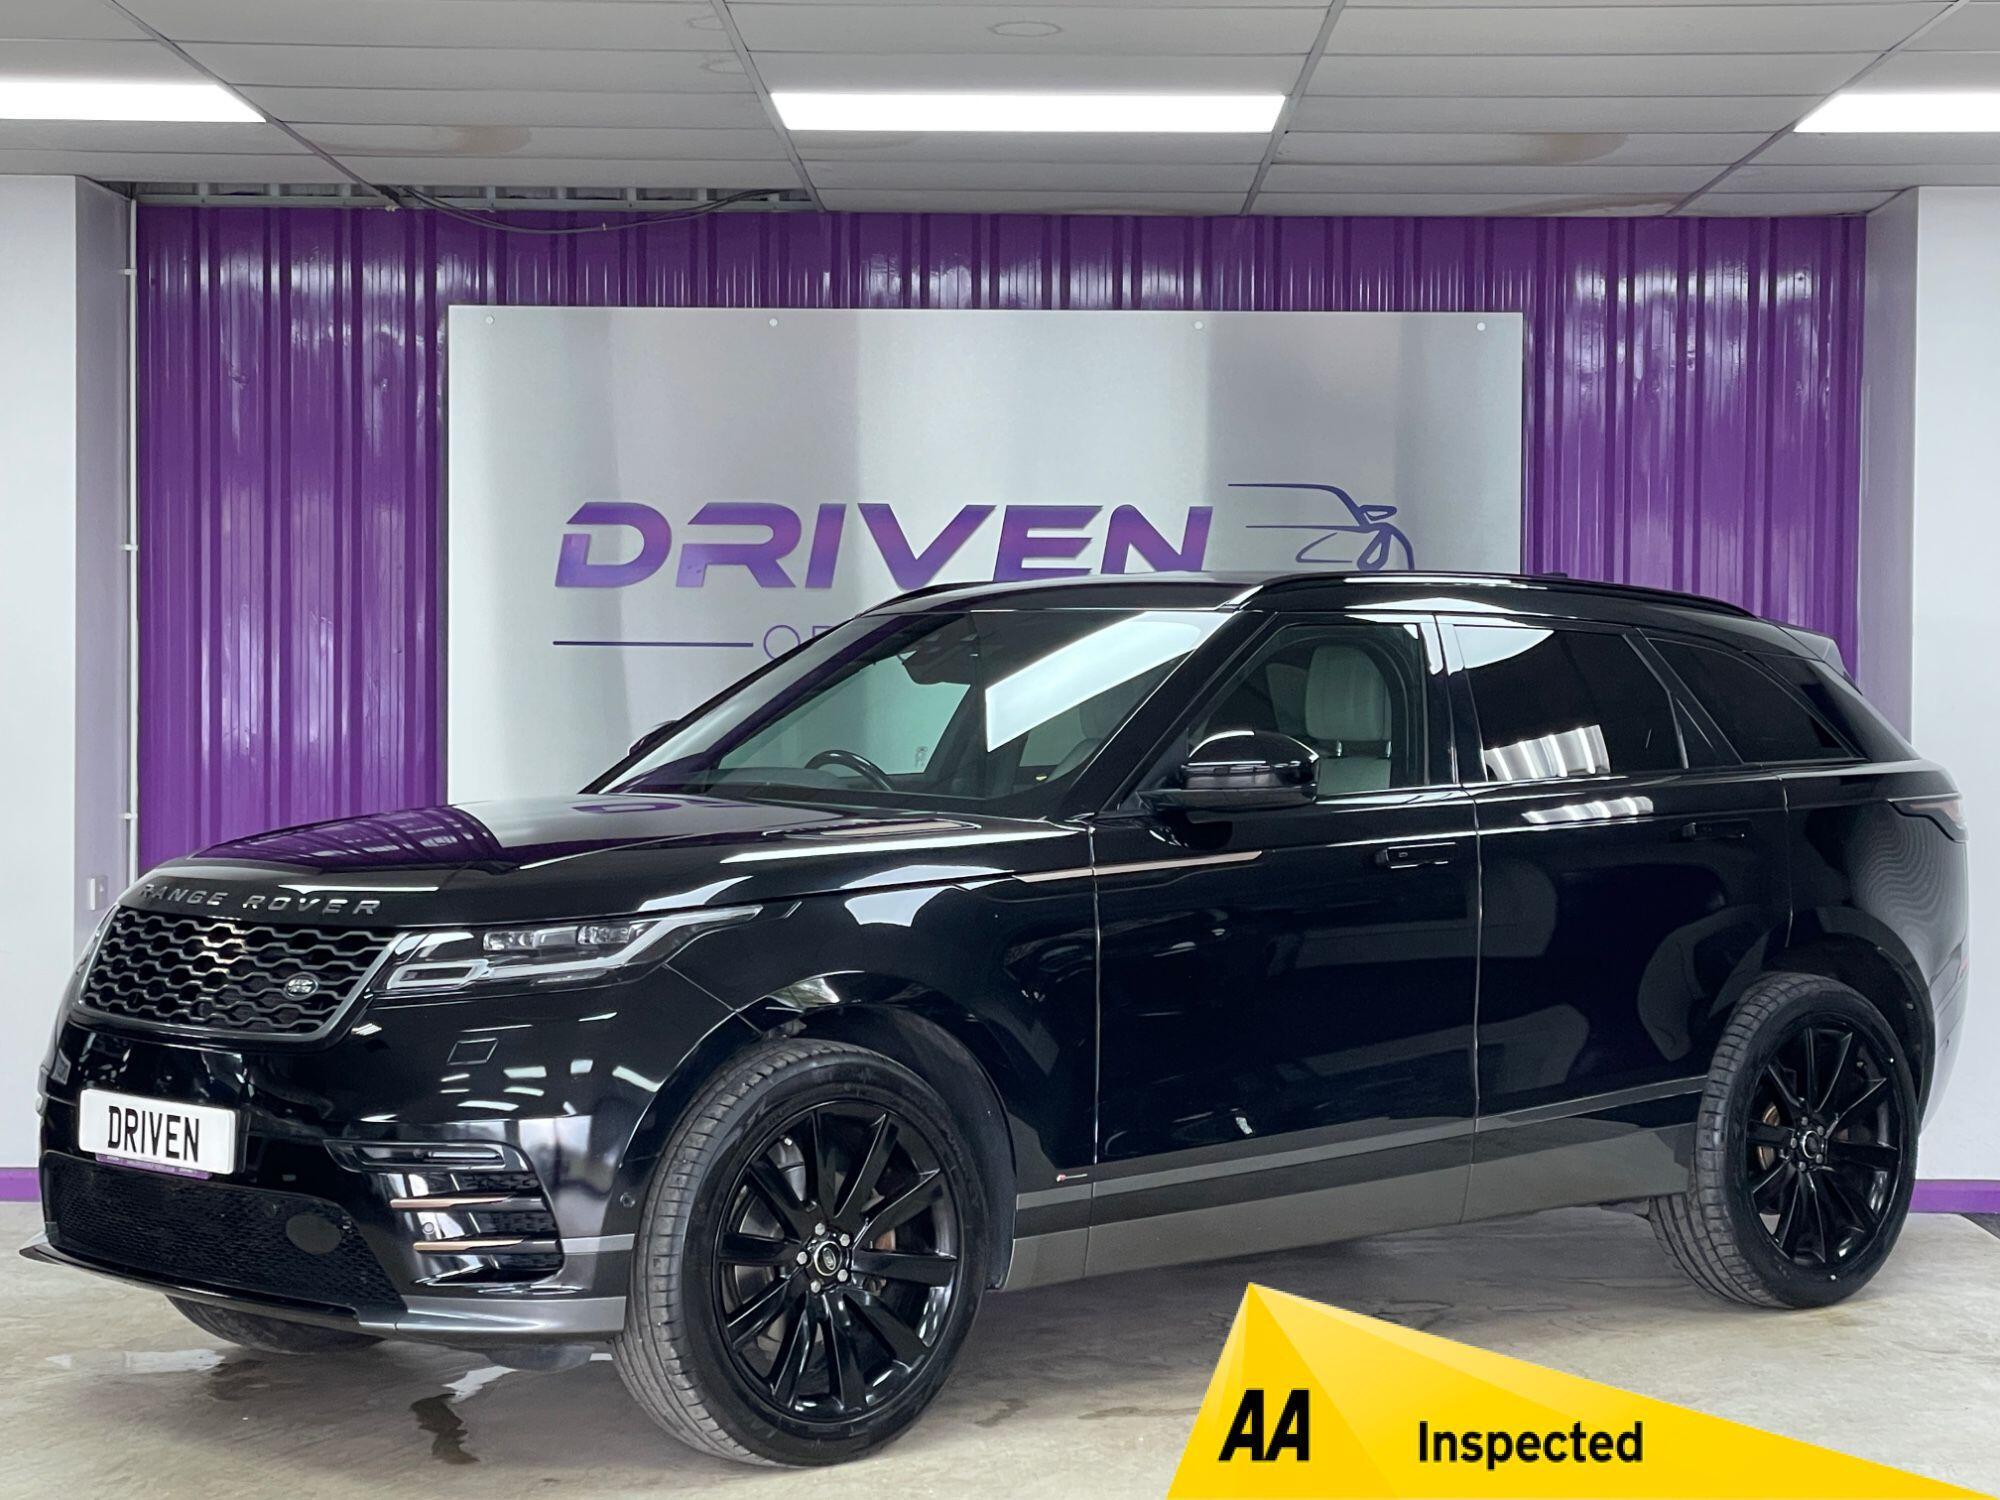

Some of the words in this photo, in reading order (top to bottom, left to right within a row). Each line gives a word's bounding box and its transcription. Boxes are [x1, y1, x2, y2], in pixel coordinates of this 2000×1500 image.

[554, 502, 1213, 591] DRIVEN
[138, 882, 229, 907] RANGE
[242, 894, 381, 916] ROVER
[107, 1104, 200, 1163] DRIVEN
